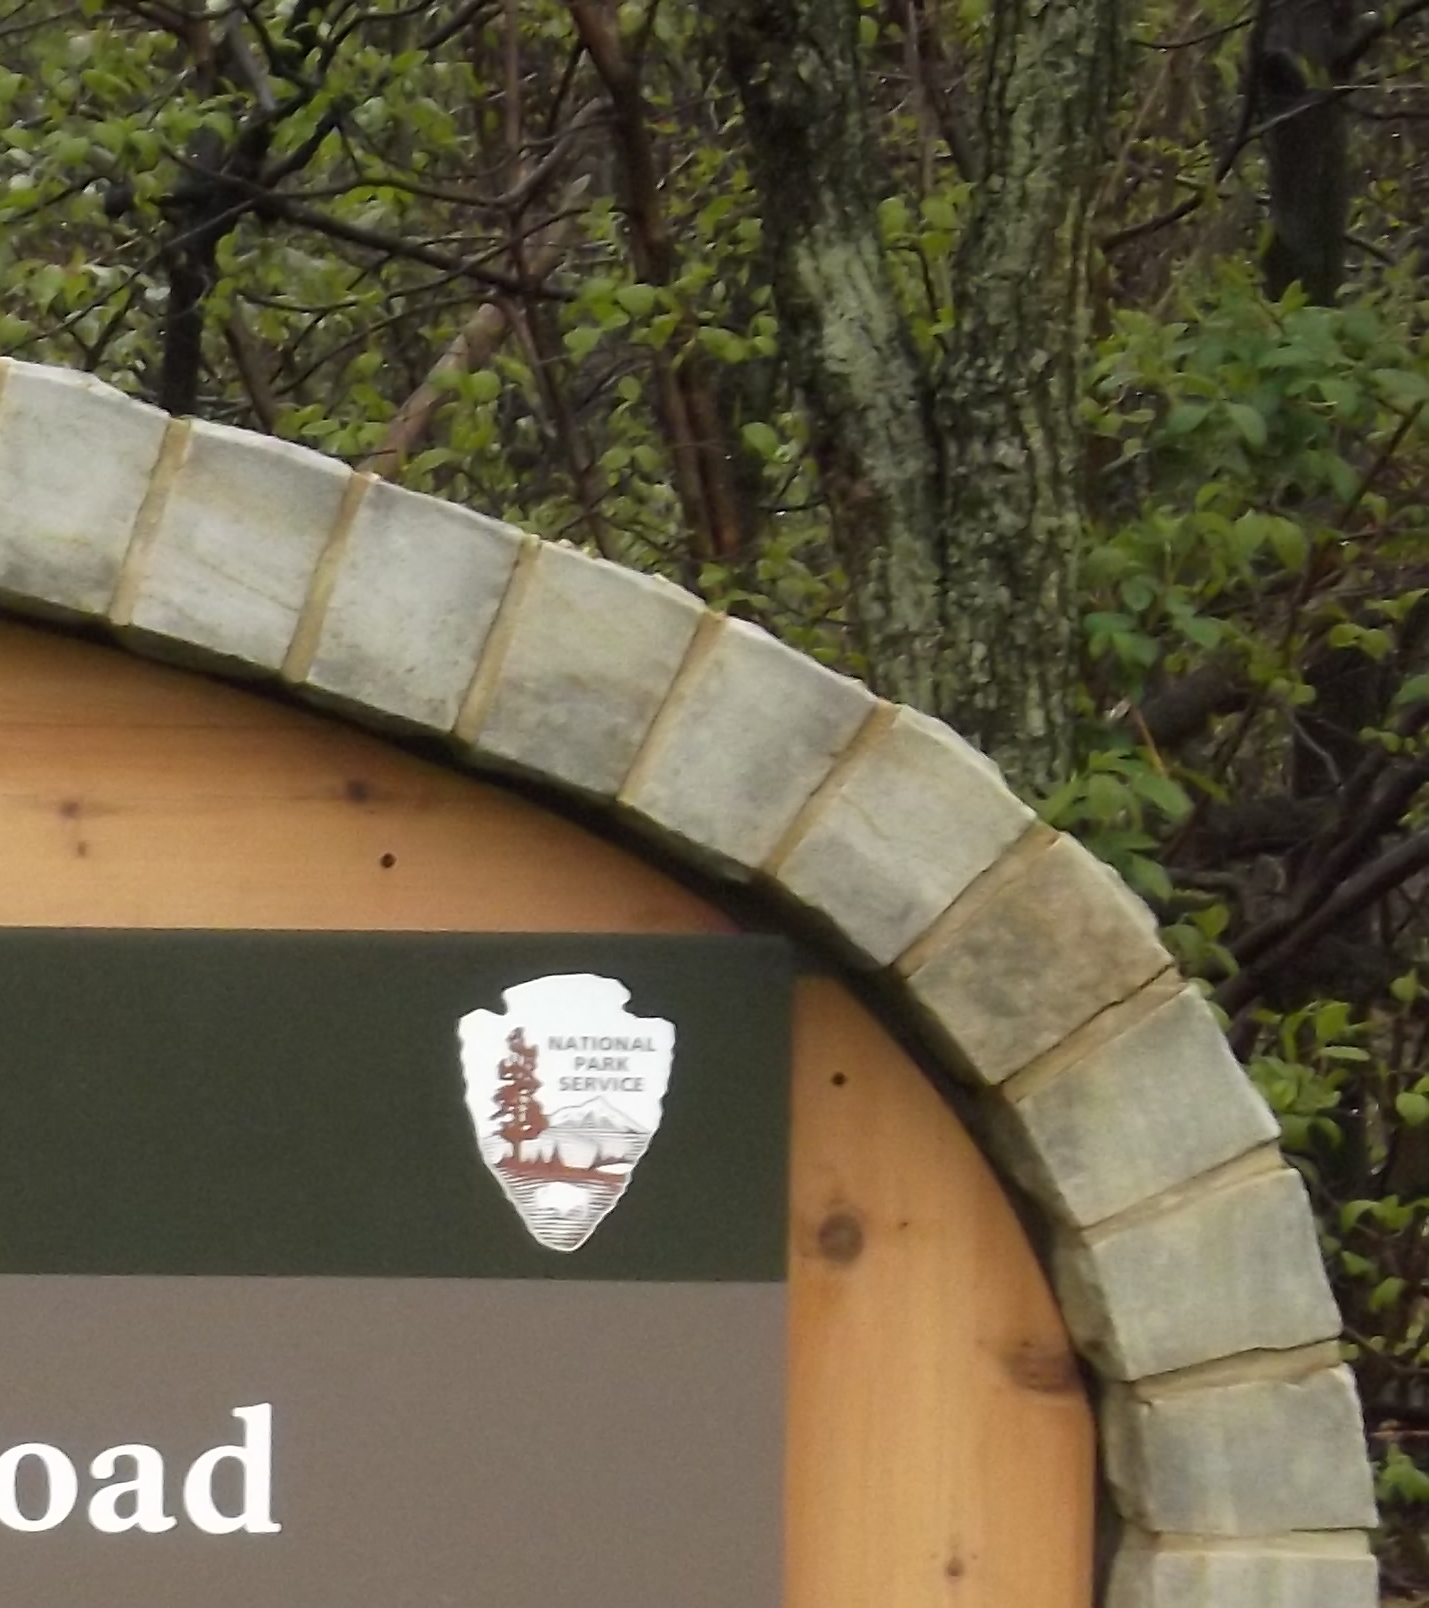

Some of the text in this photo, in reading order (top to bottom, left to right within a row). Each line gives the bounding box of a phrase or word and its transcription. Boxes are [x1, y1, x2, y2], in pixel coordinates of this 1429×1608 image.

[548, 1036, 656, 1051] NATIONAL
[574, 1056, 629, 1071] PARK
[559, 1077, 645, 1092] SERVICE
